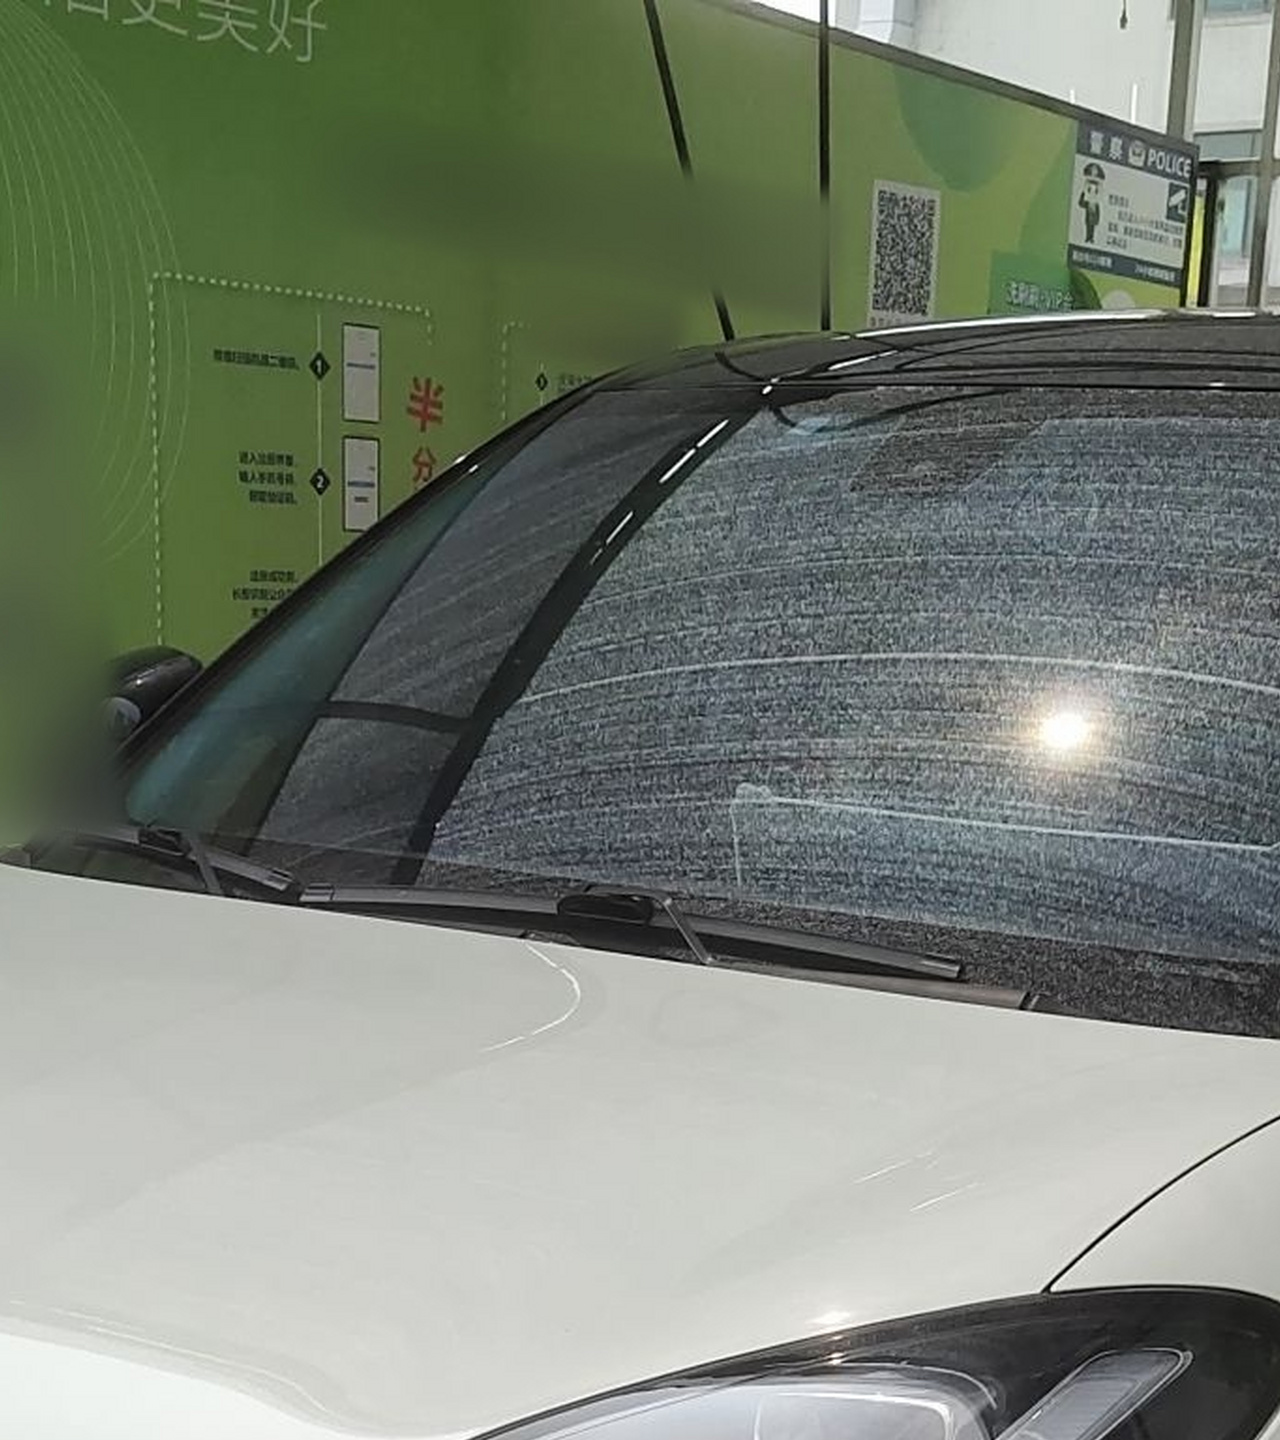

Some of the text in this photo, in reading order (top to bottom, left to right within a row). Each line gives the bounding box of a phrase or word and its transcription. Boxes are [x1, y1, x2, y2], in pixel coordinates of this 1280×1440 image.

[45, 0, 327, 62] 美好
[1147, 148, 1192, 179] POLICE
[407, 376, 444, 483] 半分
